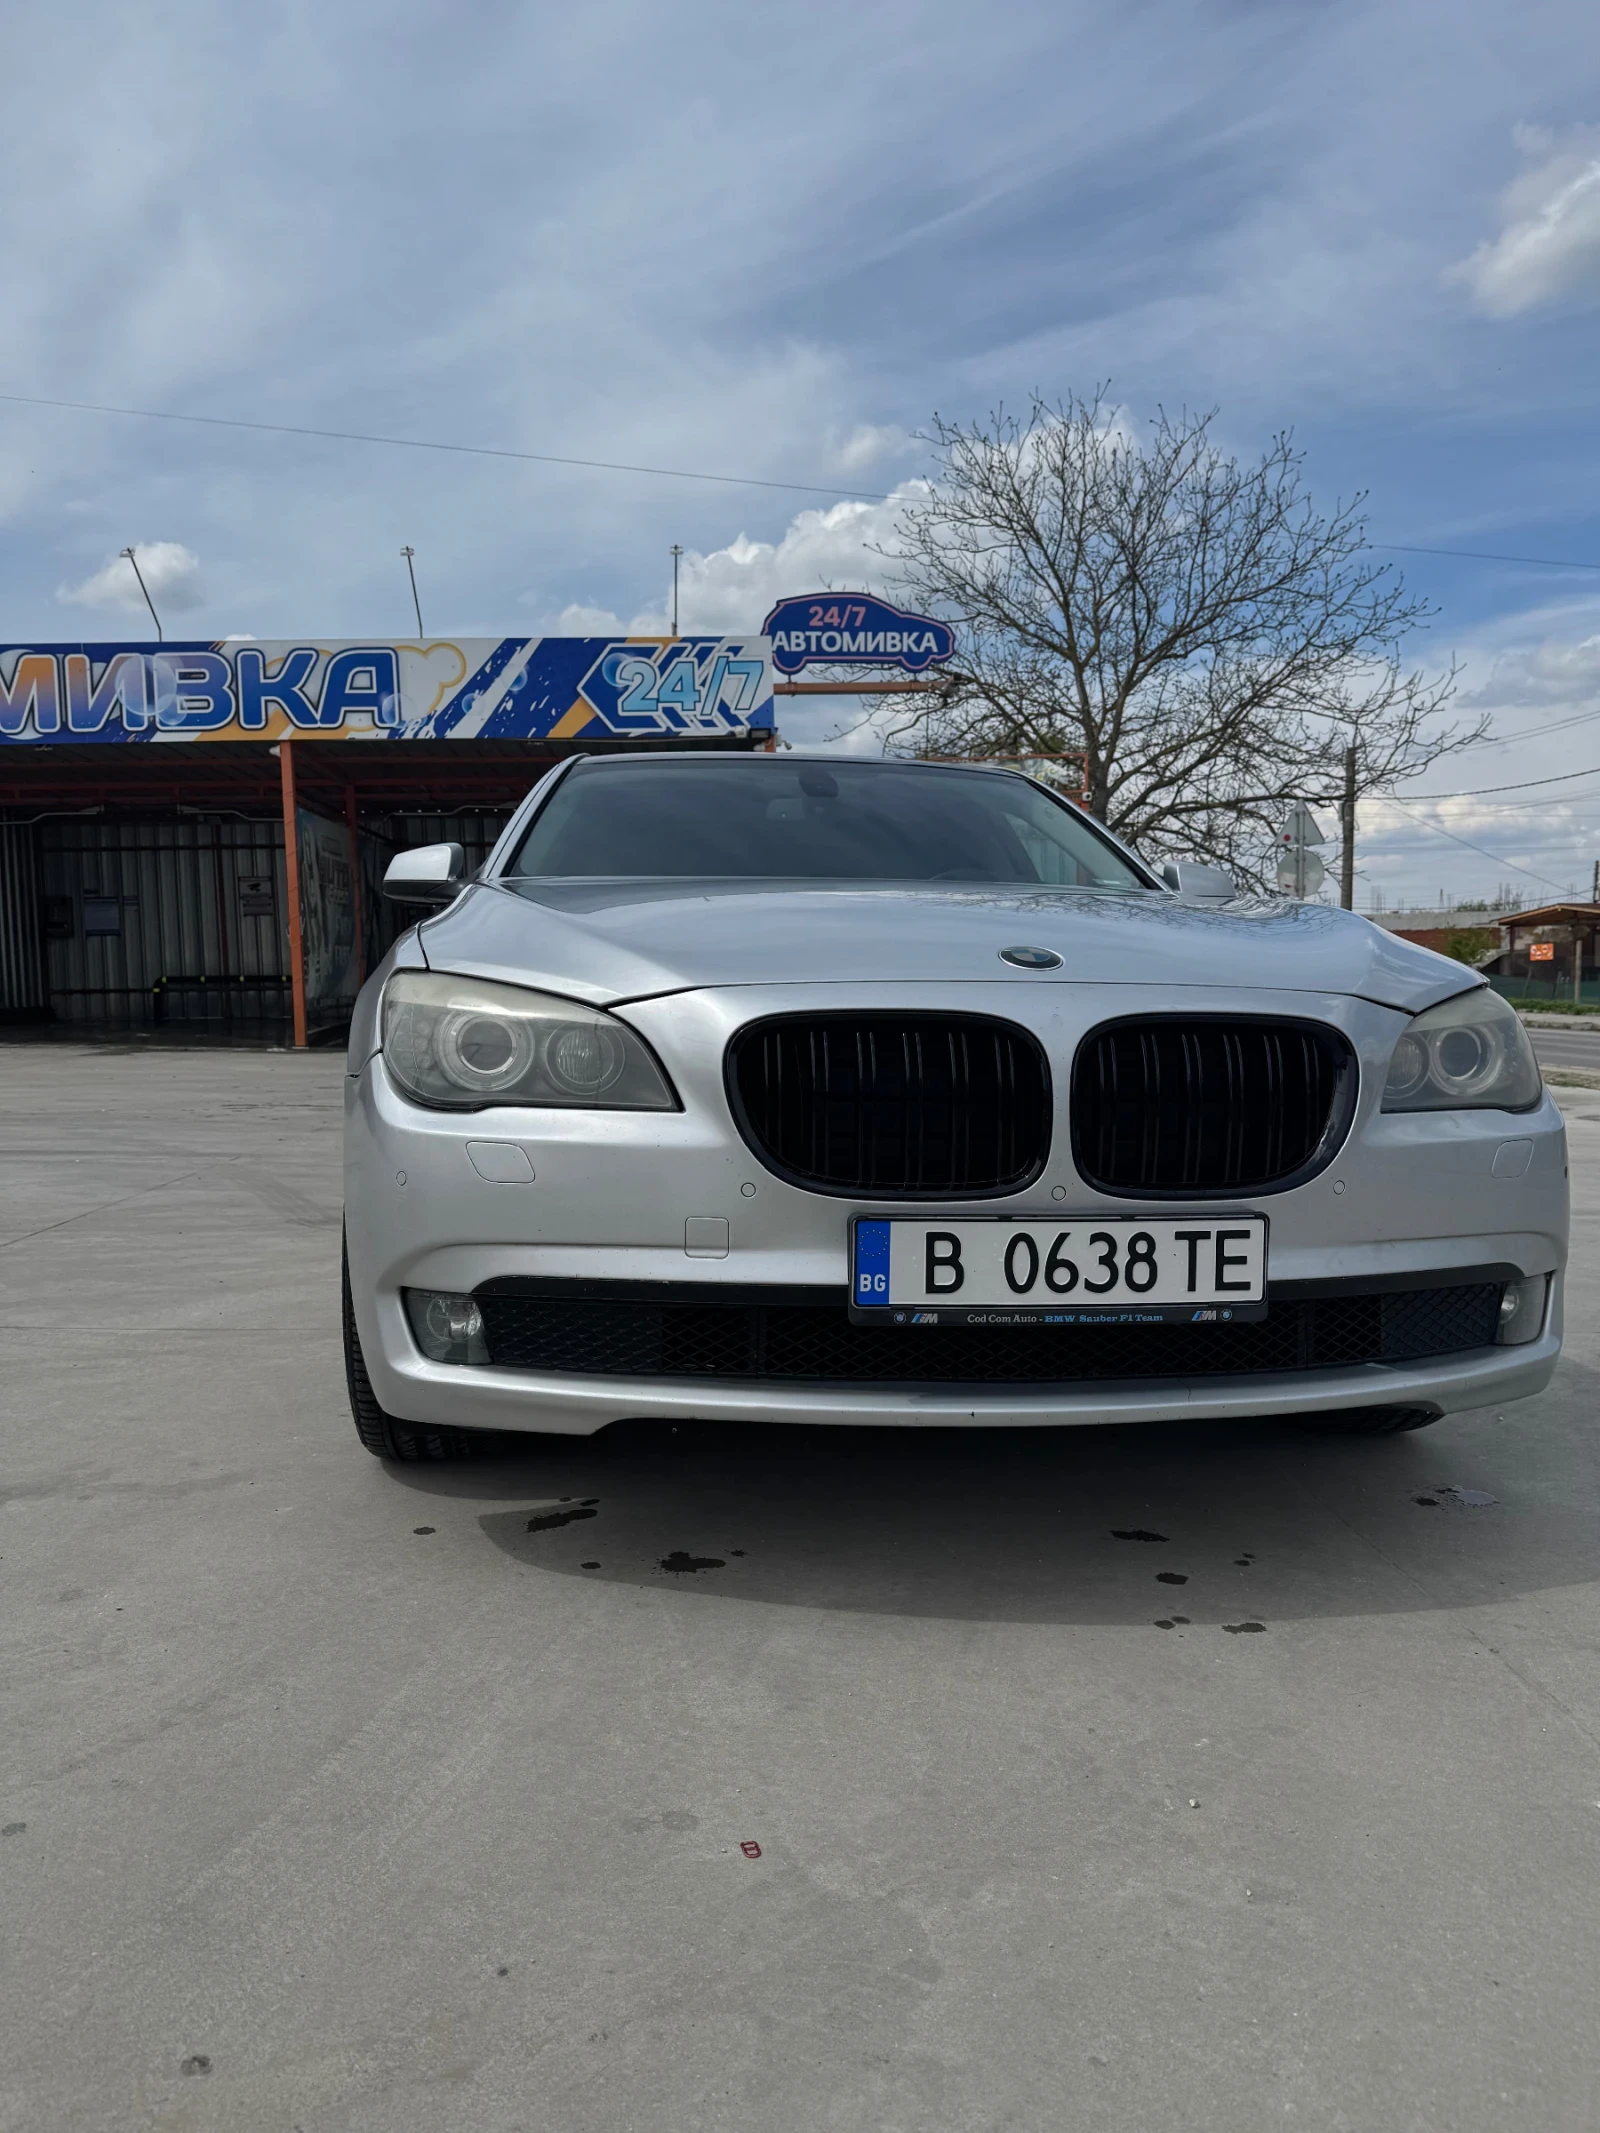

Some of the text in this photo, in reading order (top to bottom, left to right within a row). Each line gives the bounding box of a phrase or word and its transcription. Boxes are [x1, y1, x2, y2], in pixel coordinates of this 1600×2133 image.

[808, 604, 866, 628] 24/7
[772, 631, 938, 653] АВТОМИВКА
[618, 653, 764, 717] 24/7
[925, 1229, 1251, 1294] B 0638 TE
[859, 1274, 886, 1292] BG
[967, 1314, 987, 1323] Cod
[988, 1315, 1011, 1323] Com
[1013, 1315, 1037, 1323] Auto
[1044, 1315, 1075, 1323] BMW
[1079, 1314, 1118, 1322] Sauber
[1135, 1314, 1164, 1322] Team
